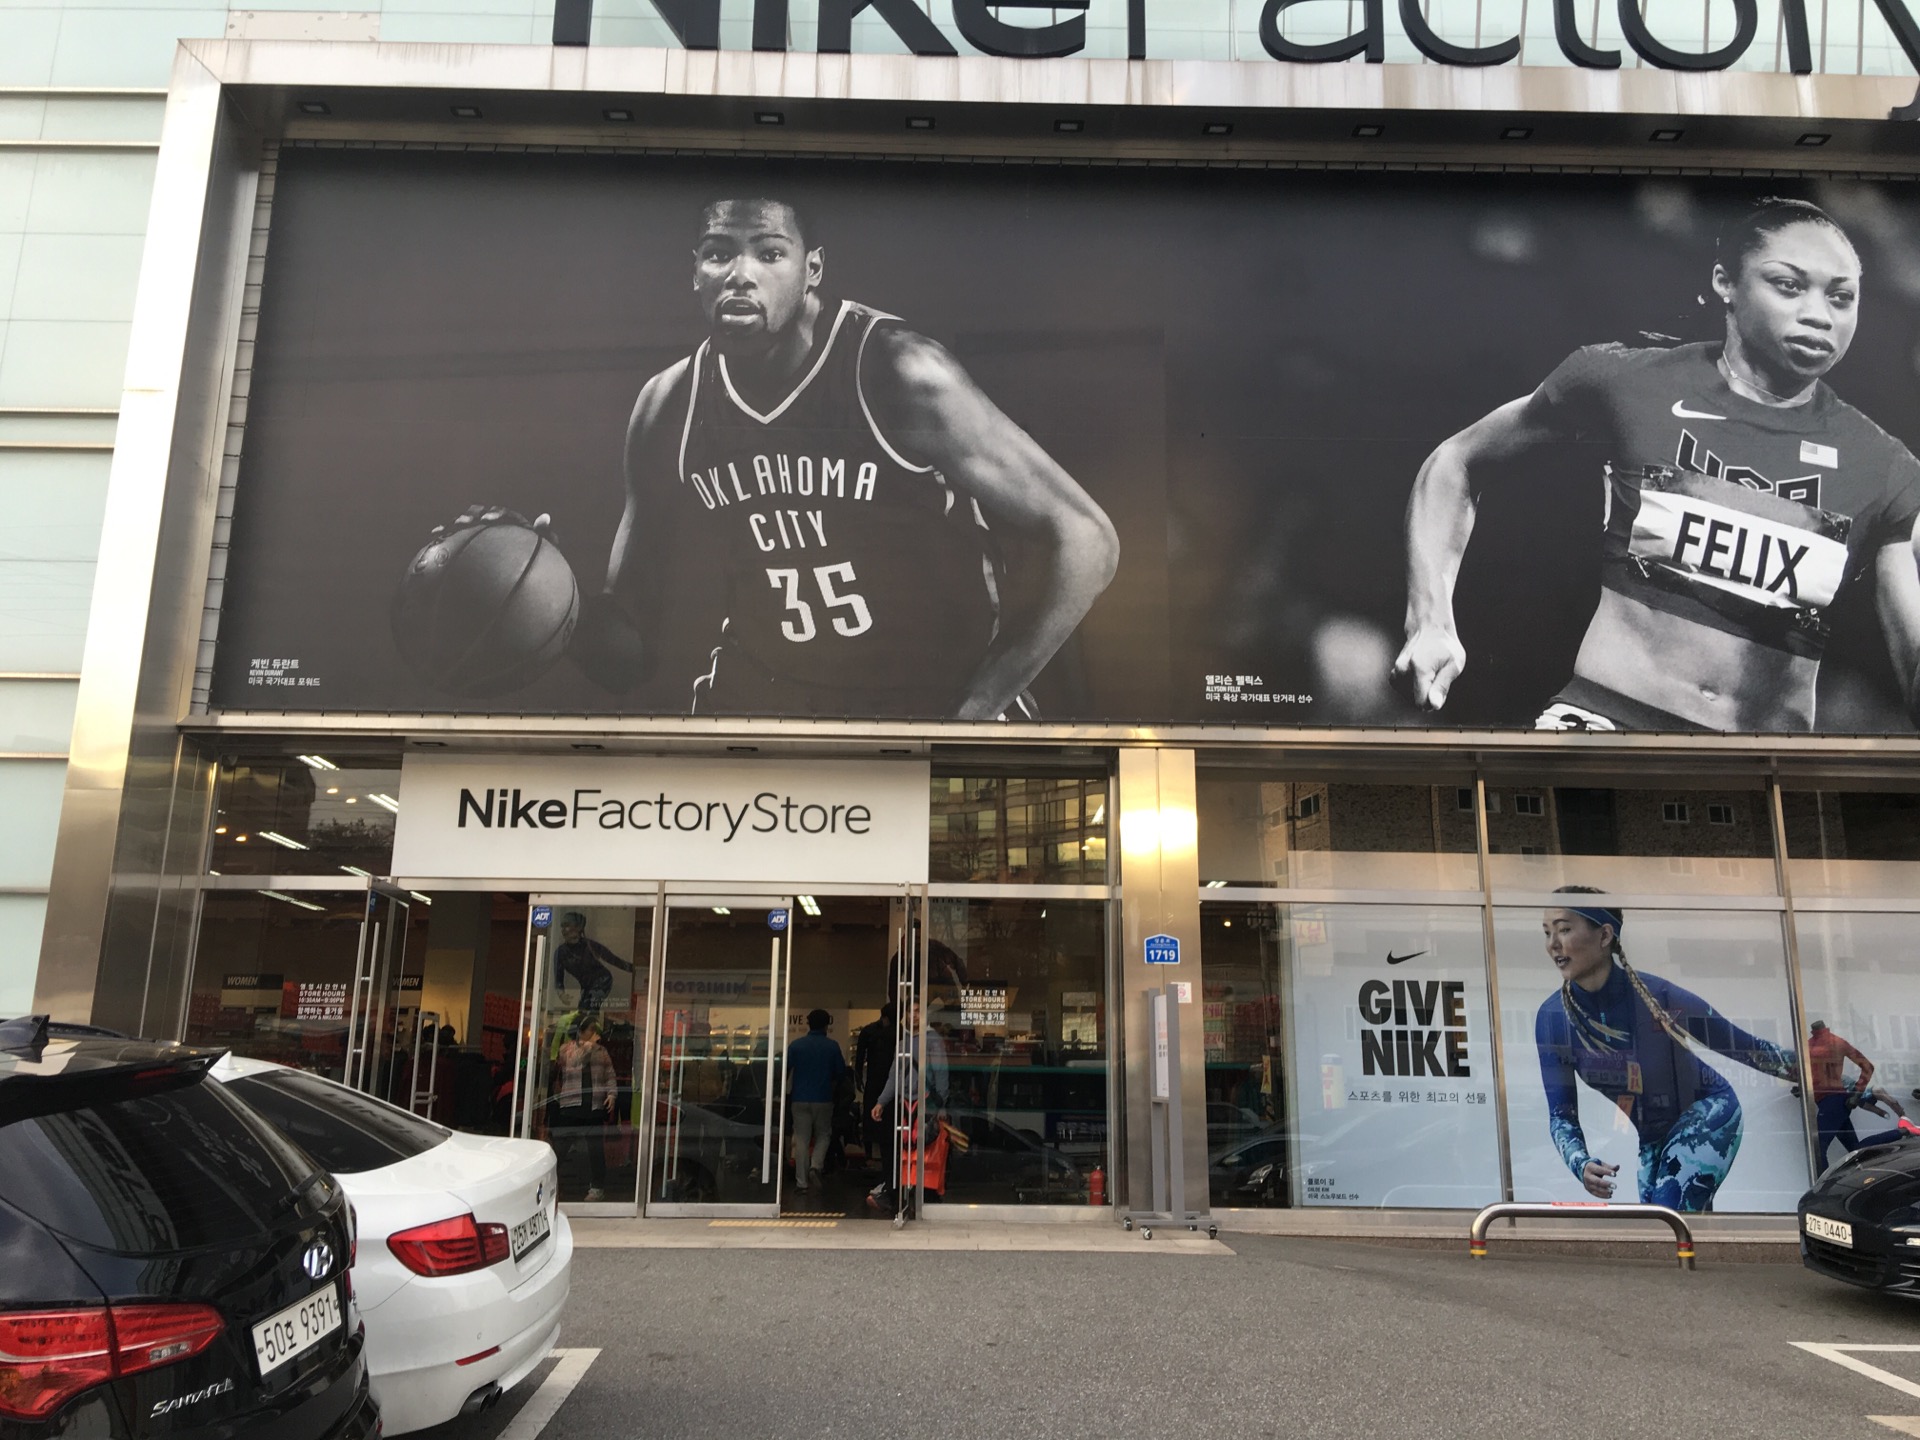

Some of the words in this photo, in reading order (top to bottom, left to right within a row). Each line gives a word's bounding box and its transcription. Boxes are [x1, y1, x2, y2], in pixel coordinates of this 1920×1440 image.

[690, 453, 878, 510] OKLAHOMA
[749, 509, 828, 552] CITY
[1671, 510, 1810, 598] FELIX
[765, 561, 873, 643] 35
[250, 658, 270, 669] 케빈
[271, 658, 299, 669] 듀란트
[248, 677, 264, 686] 미국
[265, 677, 295, 686] 국가대표
[297, 677, 320, 687] 포워드
[1235, 675, 1263, 686] 펠릭스
[1205, 693, 1220, 702] 미국
[1223, 693, 1238, 702] 육상
[1240, 693, 1271, 703] 국가대표
[1272, 694, 1296, 703] 단거리
[1297, 694, 1313, 704] 선수
[457, 787, 872, 843] NikeFactoryStore
[534, 912, 551, 921] ADT
[770, 915, 787, 924] ADT
[1149, 949, 1176, 961] 1719
[227, 976, 258, 986] WOMEN
[1358, 979, 1467, 1026] GIVE
[1360, 1029, 1471, 1077] NIKE
[1347, 1090, 1392, 1103] 스포츠를
[1398, 1090, 1420, 1103] 위한
[1426, 1091, 1459, 1103] 최고의
[1465, 1092, 1487, 1104] 선물
[1824, 1221, 1847, 1240] 0440
[263, 1319, 297, 1364] 50호
[300, 1292, 335, 1341] 9391
